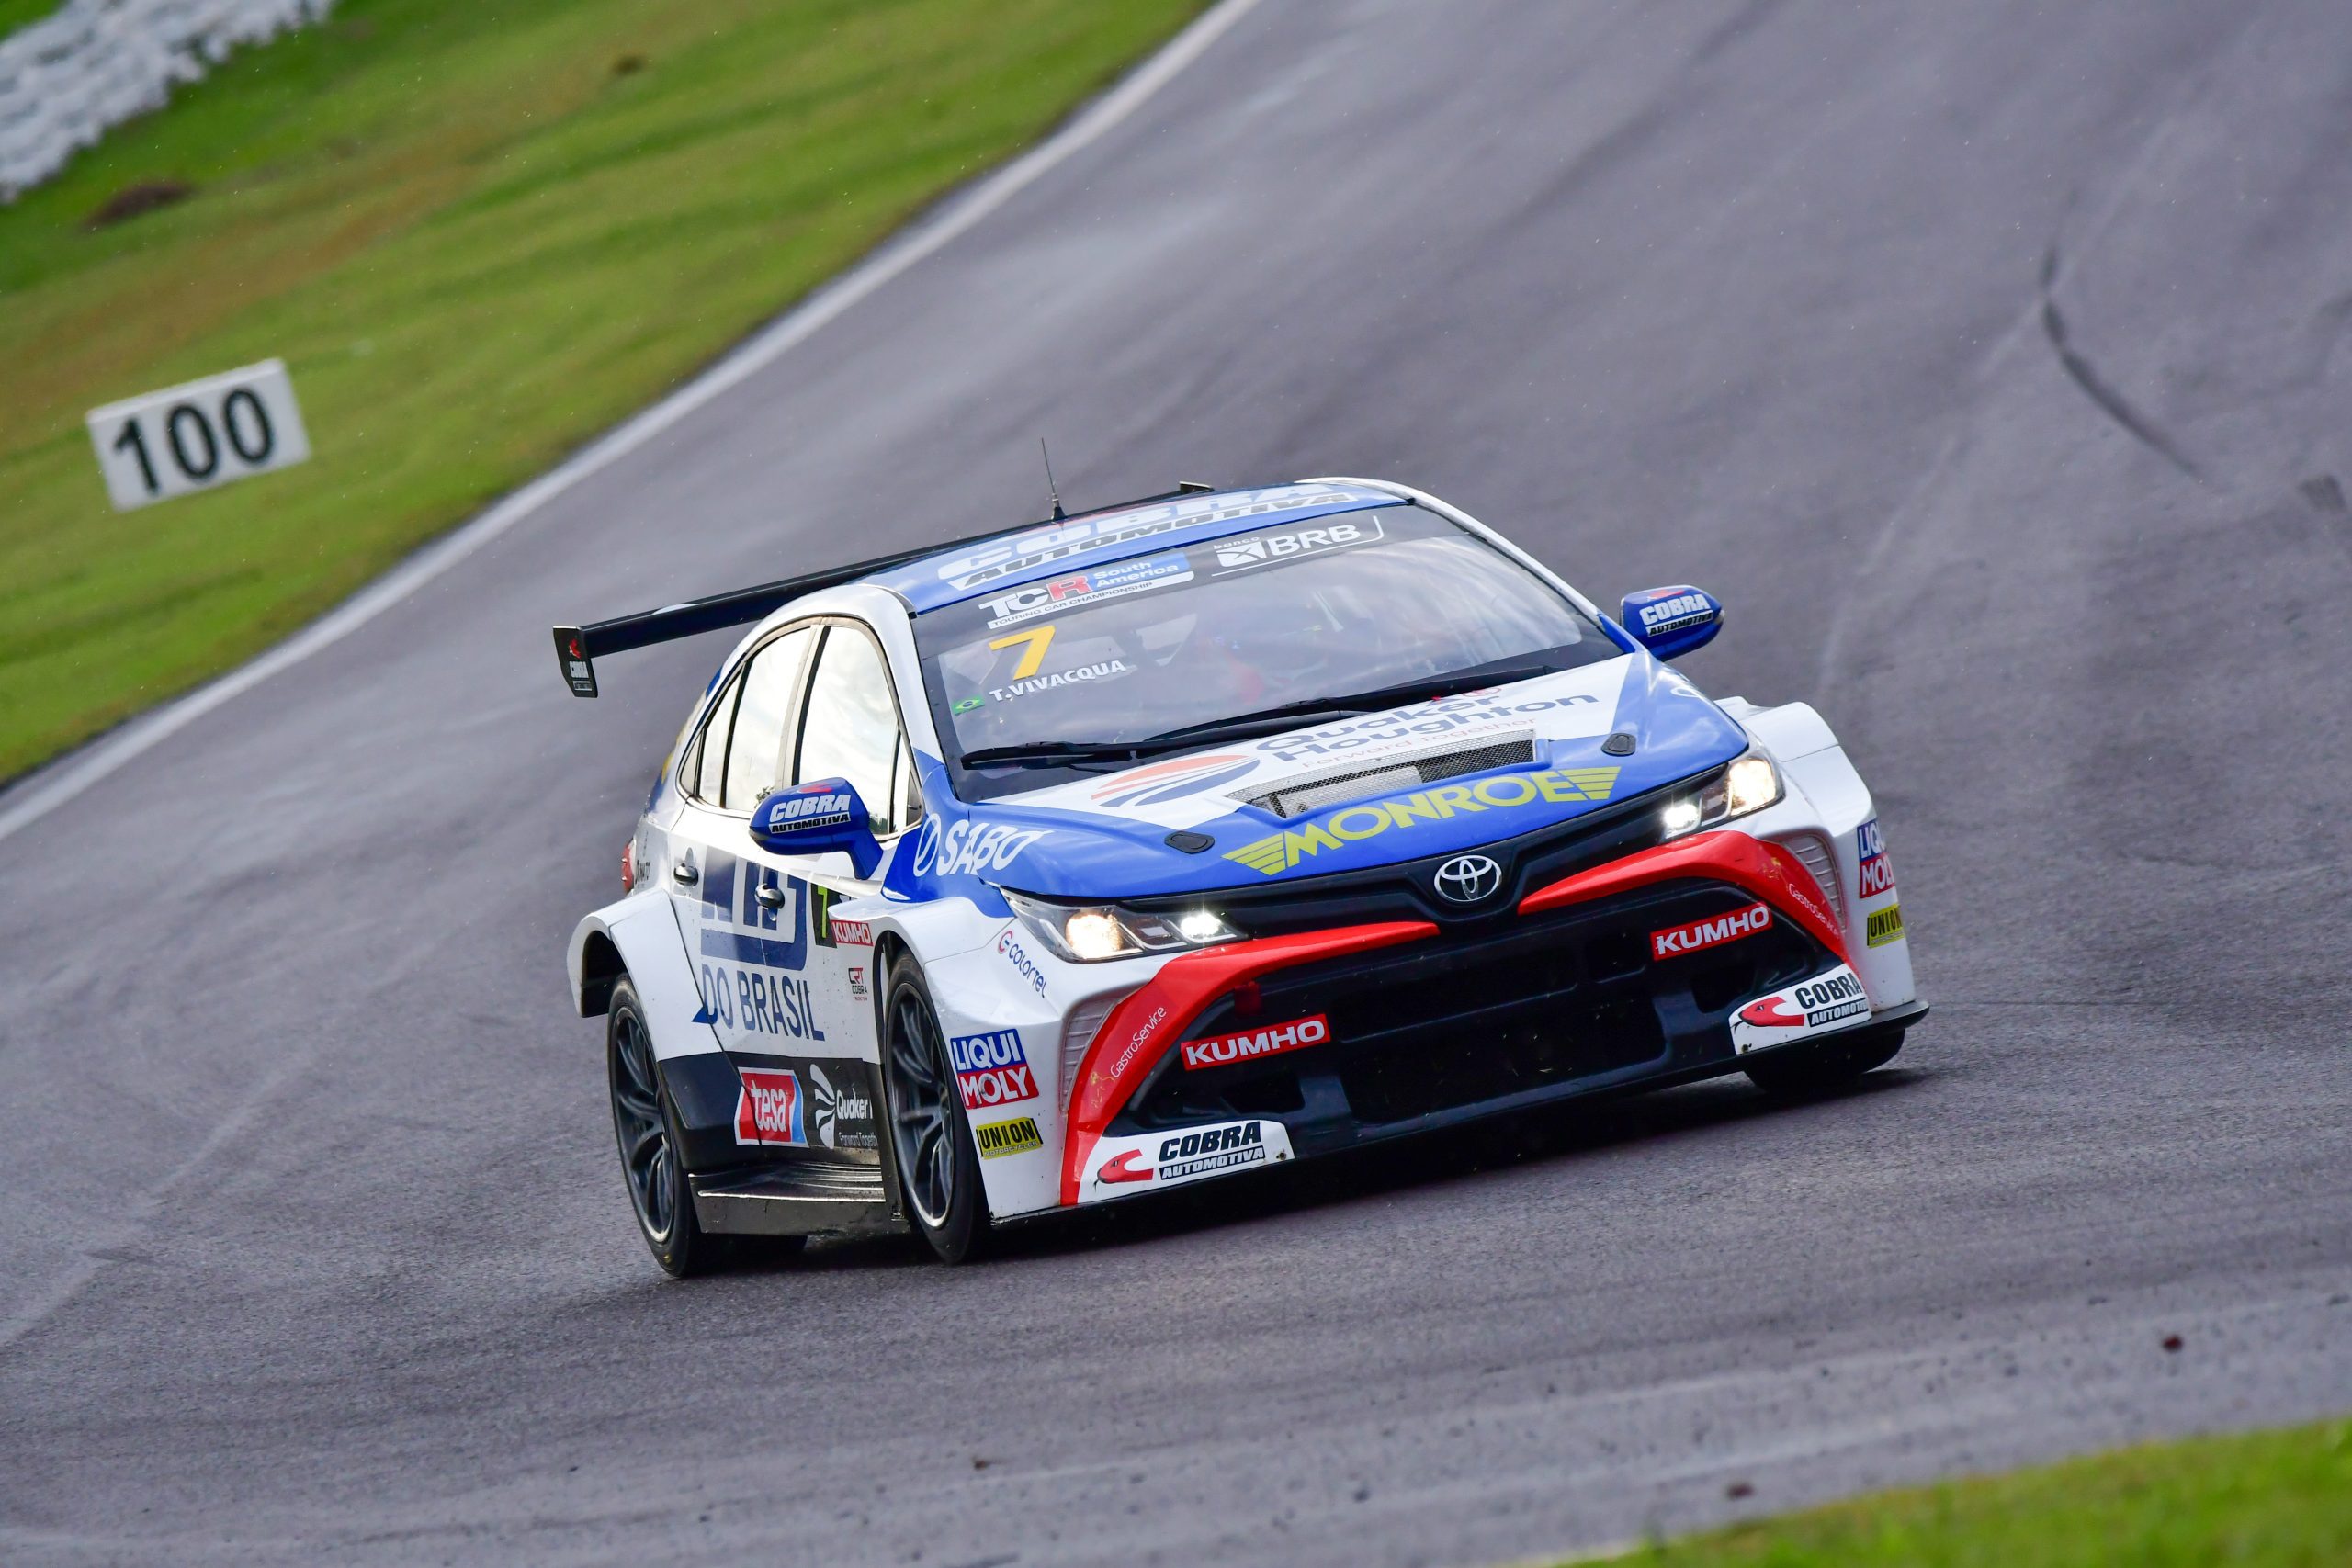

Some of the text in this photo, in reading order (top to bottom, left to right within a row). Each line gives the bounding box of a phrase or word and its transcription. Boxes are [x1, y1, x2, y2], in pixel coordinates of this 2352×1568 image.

[111, 386, 277, 493] 100
[938, 485, 1334, 580] COBRA
[963, 493, 1351, 588] AUTOMOTIVA
[1213, 536, 1261, 550] banco
[1267, 525, 1362, 557] BRB
[1093, 561, 1152, 581] South
[1096, 564, 1179, 588] America
[978, 575, 1093, 618] TCR
[993, 581, 1153, 626] TOURING CAR CHAMPIONSHIP
[1639, 593, 1712, 626] COBRA
[989, 625, 1056, 681] 7
[1257, 695, 1501, 750] Quaker
[1272, 694, 1600, 761] Houghton
[1302, 739, 1413, 768] Forward
[770, 794, 851, 822] COBRA
[772, 813, 850, 832] AUTOMOTIVA
[1284, 771, 1590, 866] MONROE
[831, 921, 871, 943] KUMHO
[1656, 905, 1770, 954] KUMHO
[696, 963, 825, 1041] DO BRASIL
[1795, 972, 1863, 1010] COBRA
[952, 1032, 1021, 1071] LIQUI
[1110, 1006, 1167, 1078] GastroService
[1186, 1020, 1326, 1066] KUMHO
[751, 1079, 787, 1132] tesa
[837, 1087, 868, 1119] Quaker
[960, 1066, 1029, 1106] MOLY
[978, 1120, 1036, 1149] UNION
[1159, 1121, 1261, 1162] COBRA
[1161, 1146, 1264, 1180] AUTOMOTIVA
